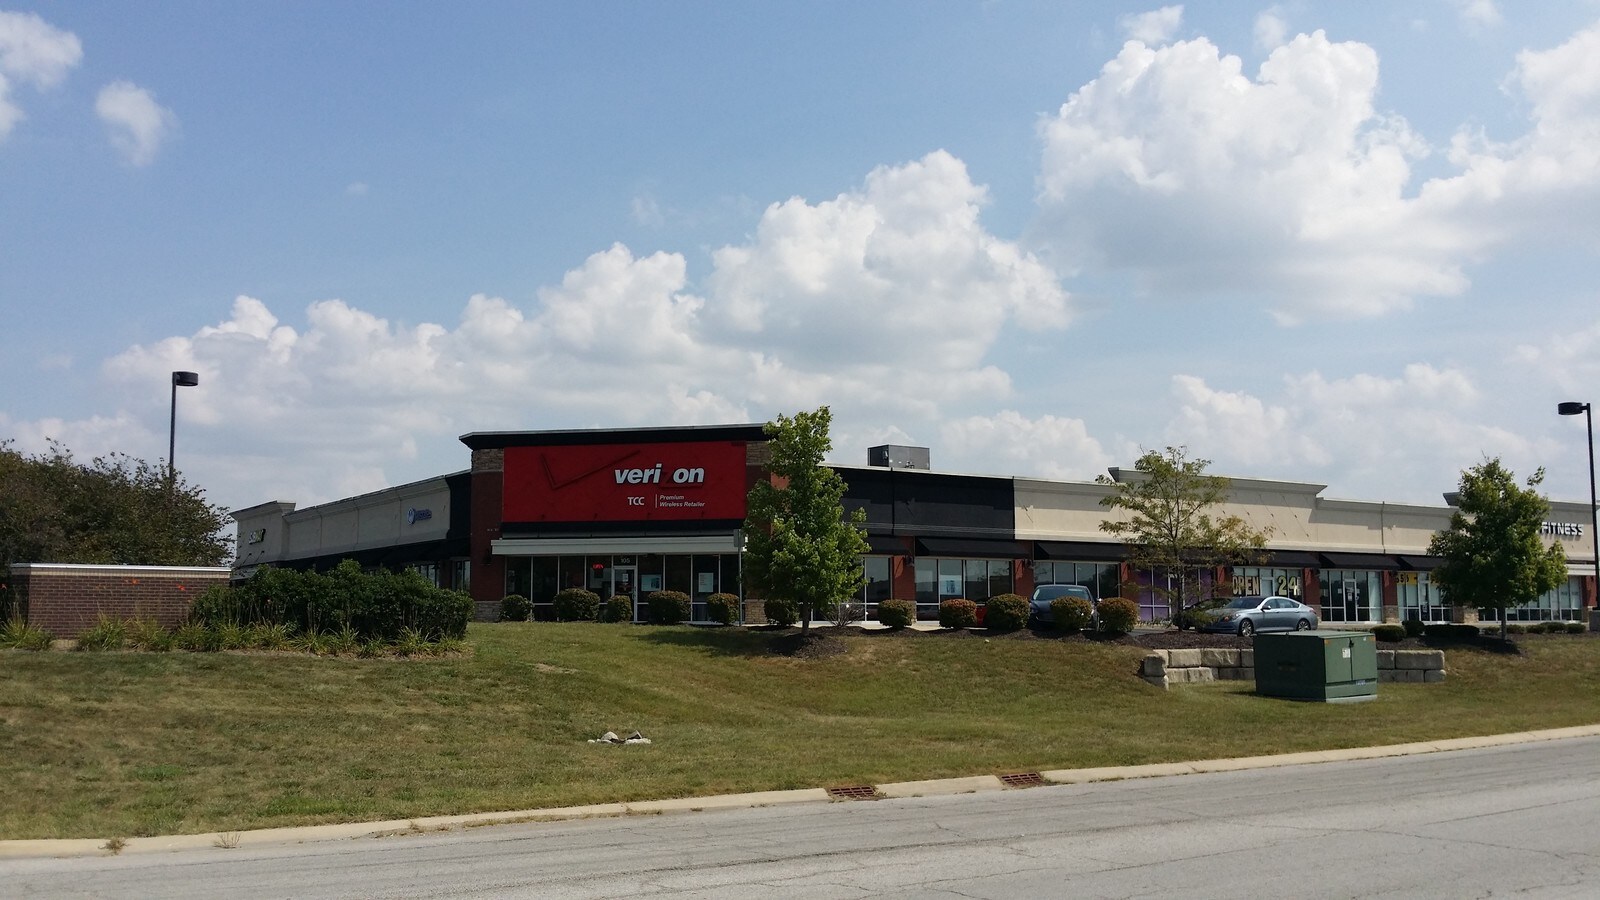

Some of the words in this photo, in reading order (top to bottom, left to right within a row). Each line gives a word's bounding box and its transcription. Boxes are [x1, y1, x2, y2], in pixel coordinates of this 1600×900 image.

[627, 496, 645, 505] TCC
[1541, 521, 1584, 536] FITNESS
[1232, 576, 1260, 596] OPEN
[1278, 575, 1297, 596] 24
